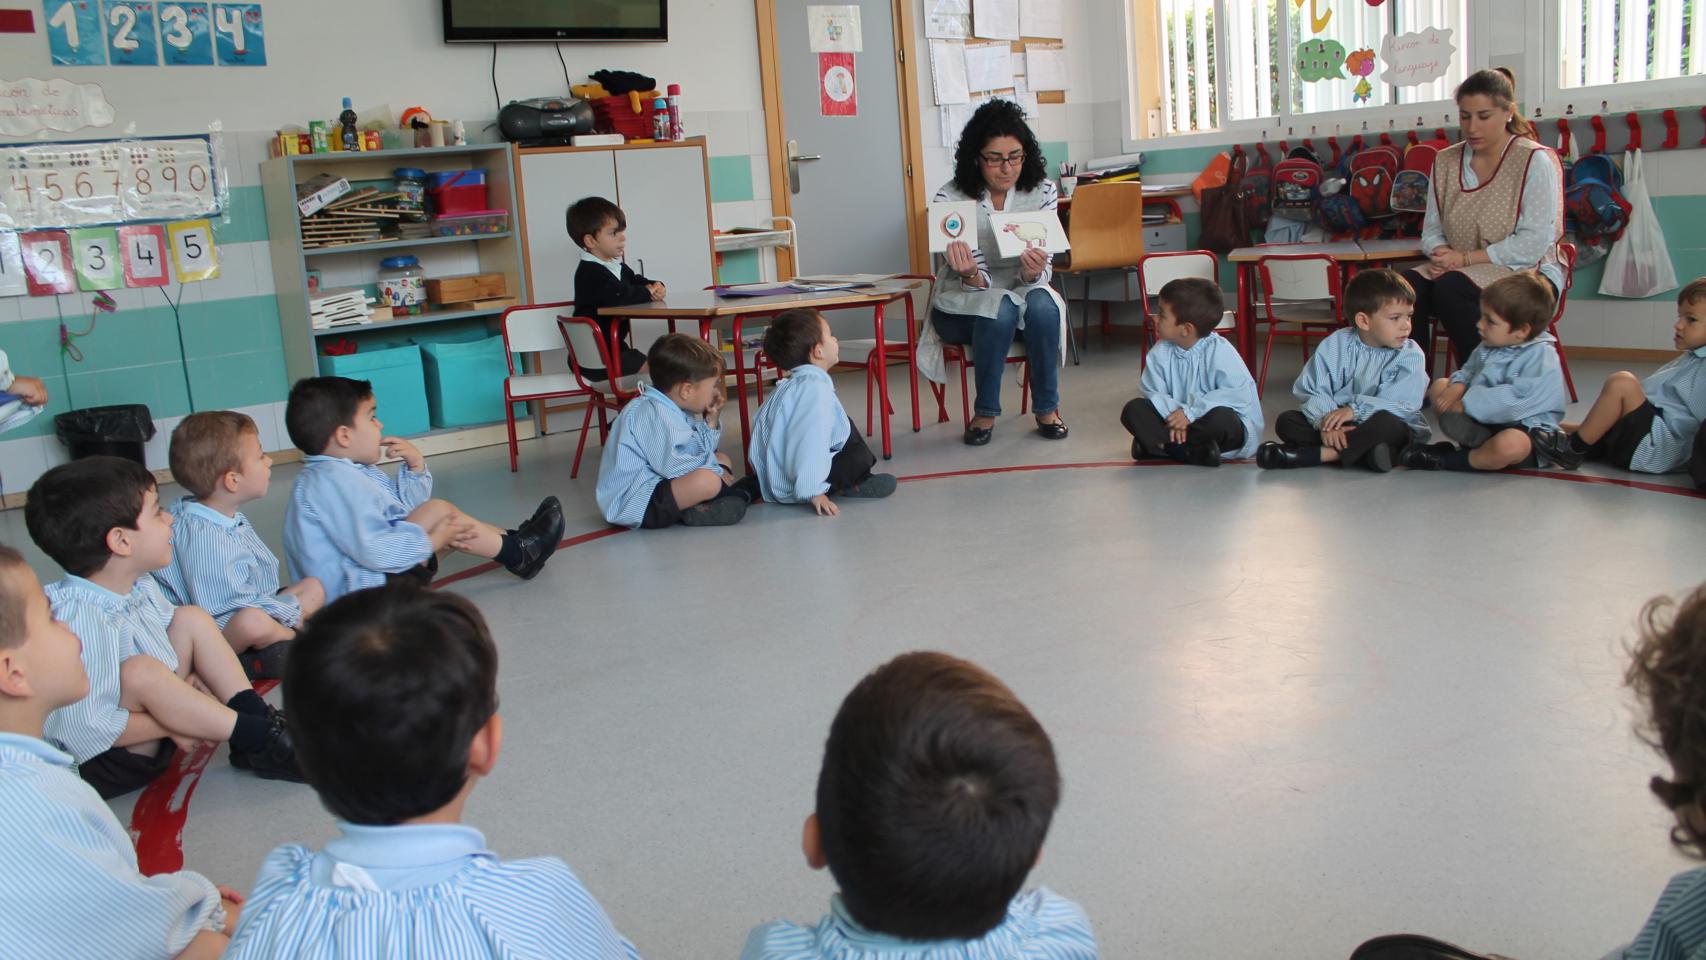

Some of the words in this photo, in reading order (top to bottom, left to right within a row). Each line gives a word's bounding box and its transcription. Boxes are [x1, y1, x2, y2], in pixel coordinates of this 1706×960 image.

[50, 1, 80, 48] 1
[110, 5, 140, 49] 2
[160, 5, 193, 48] 3
[215, 7, 245, 51] 4
[11, 173, 32, 203] 4
[44, 172, 64, 202] 5
[75, 171, 94, 198] 6
[103, 170, 123, 196] 7
[135, 167, 152, 195] 8
[161, 166, 177, 192] 9
[188, 164, 207, 192] 0
[38, 248, 55, 274] 2
[88, 245, 106, 270] 3
[136, 242, 154, 266] 4
[183, 234, 202, 260] 5
